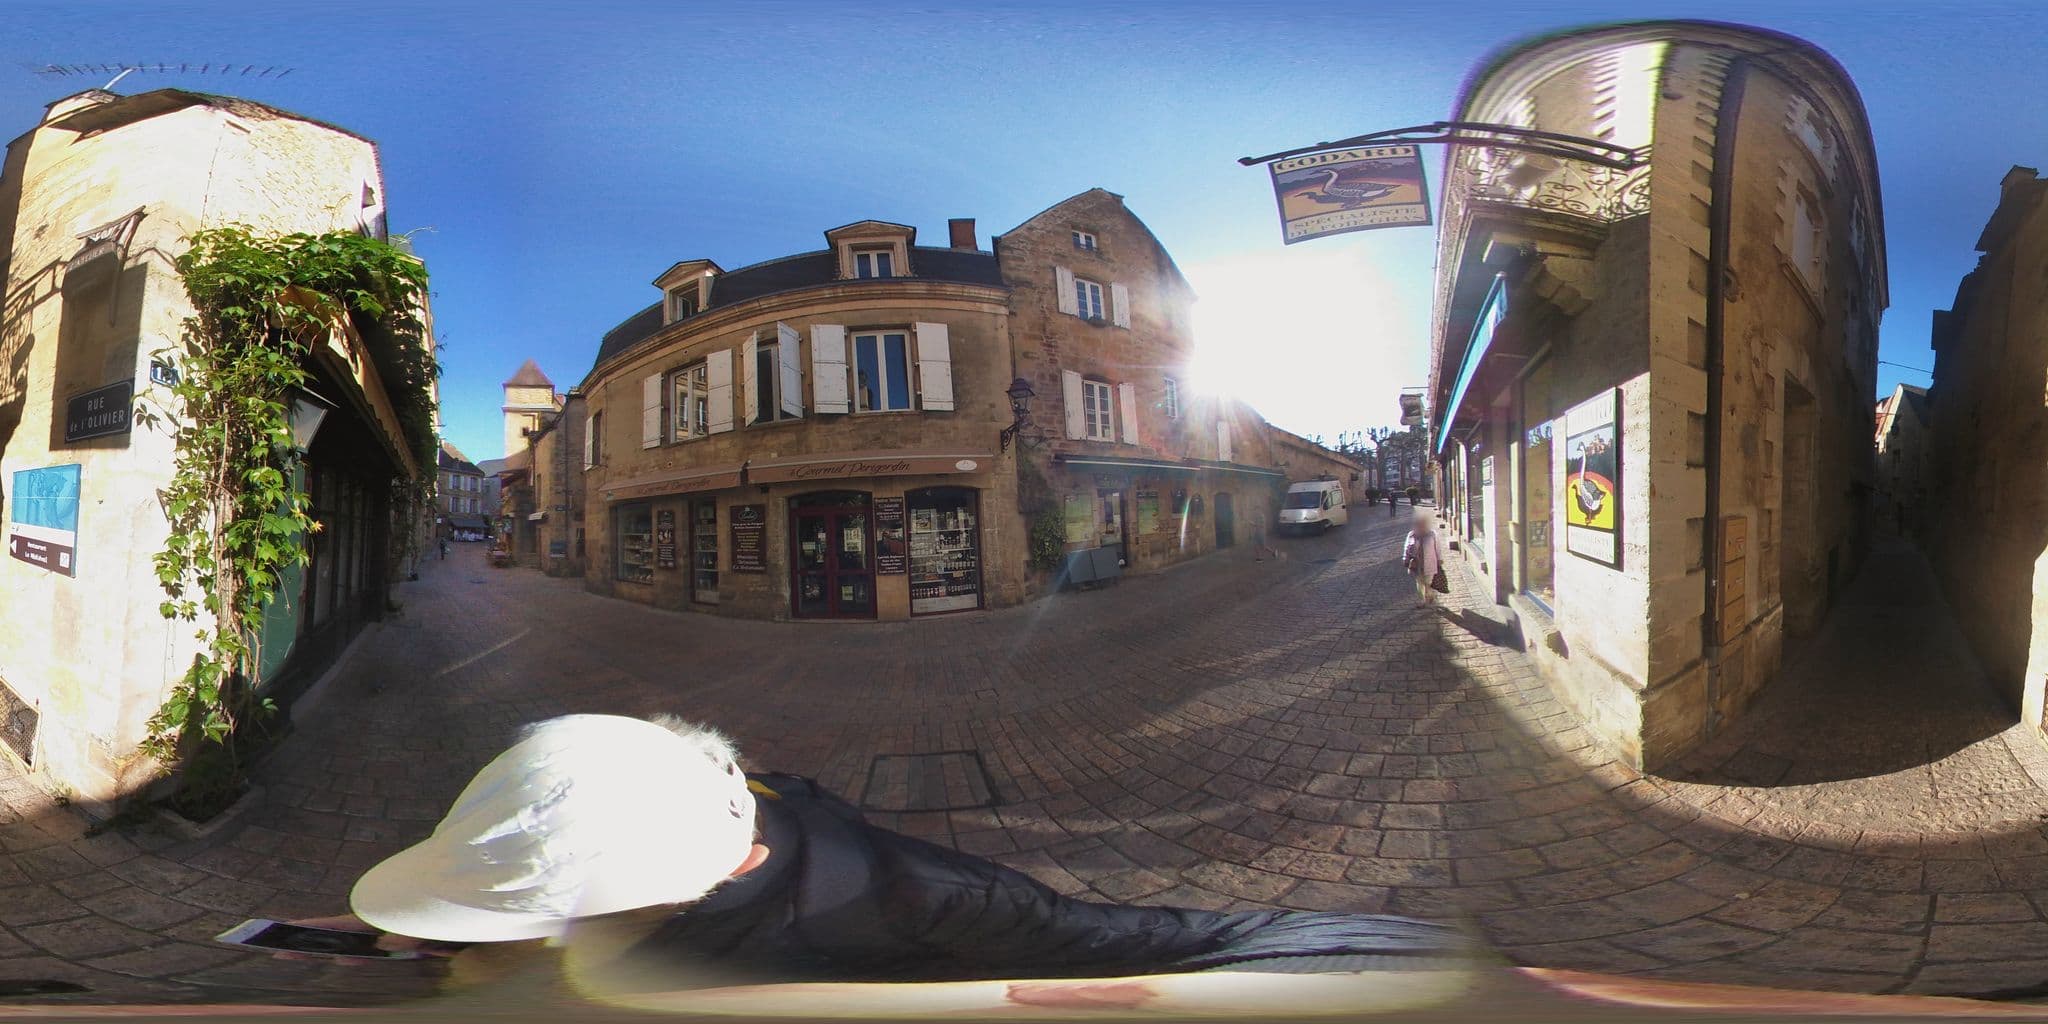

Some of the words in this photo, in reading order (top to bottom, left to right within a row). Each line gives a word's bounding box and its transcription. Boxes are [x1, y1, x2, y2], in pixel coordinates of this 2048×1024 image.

[1276, 147, 1412, 171] GODARD
[1321, 220, 1363, 231] FOIE
[1369, 214, 1425, 224] GRAS
[87, 397, 105, 411] RUE
